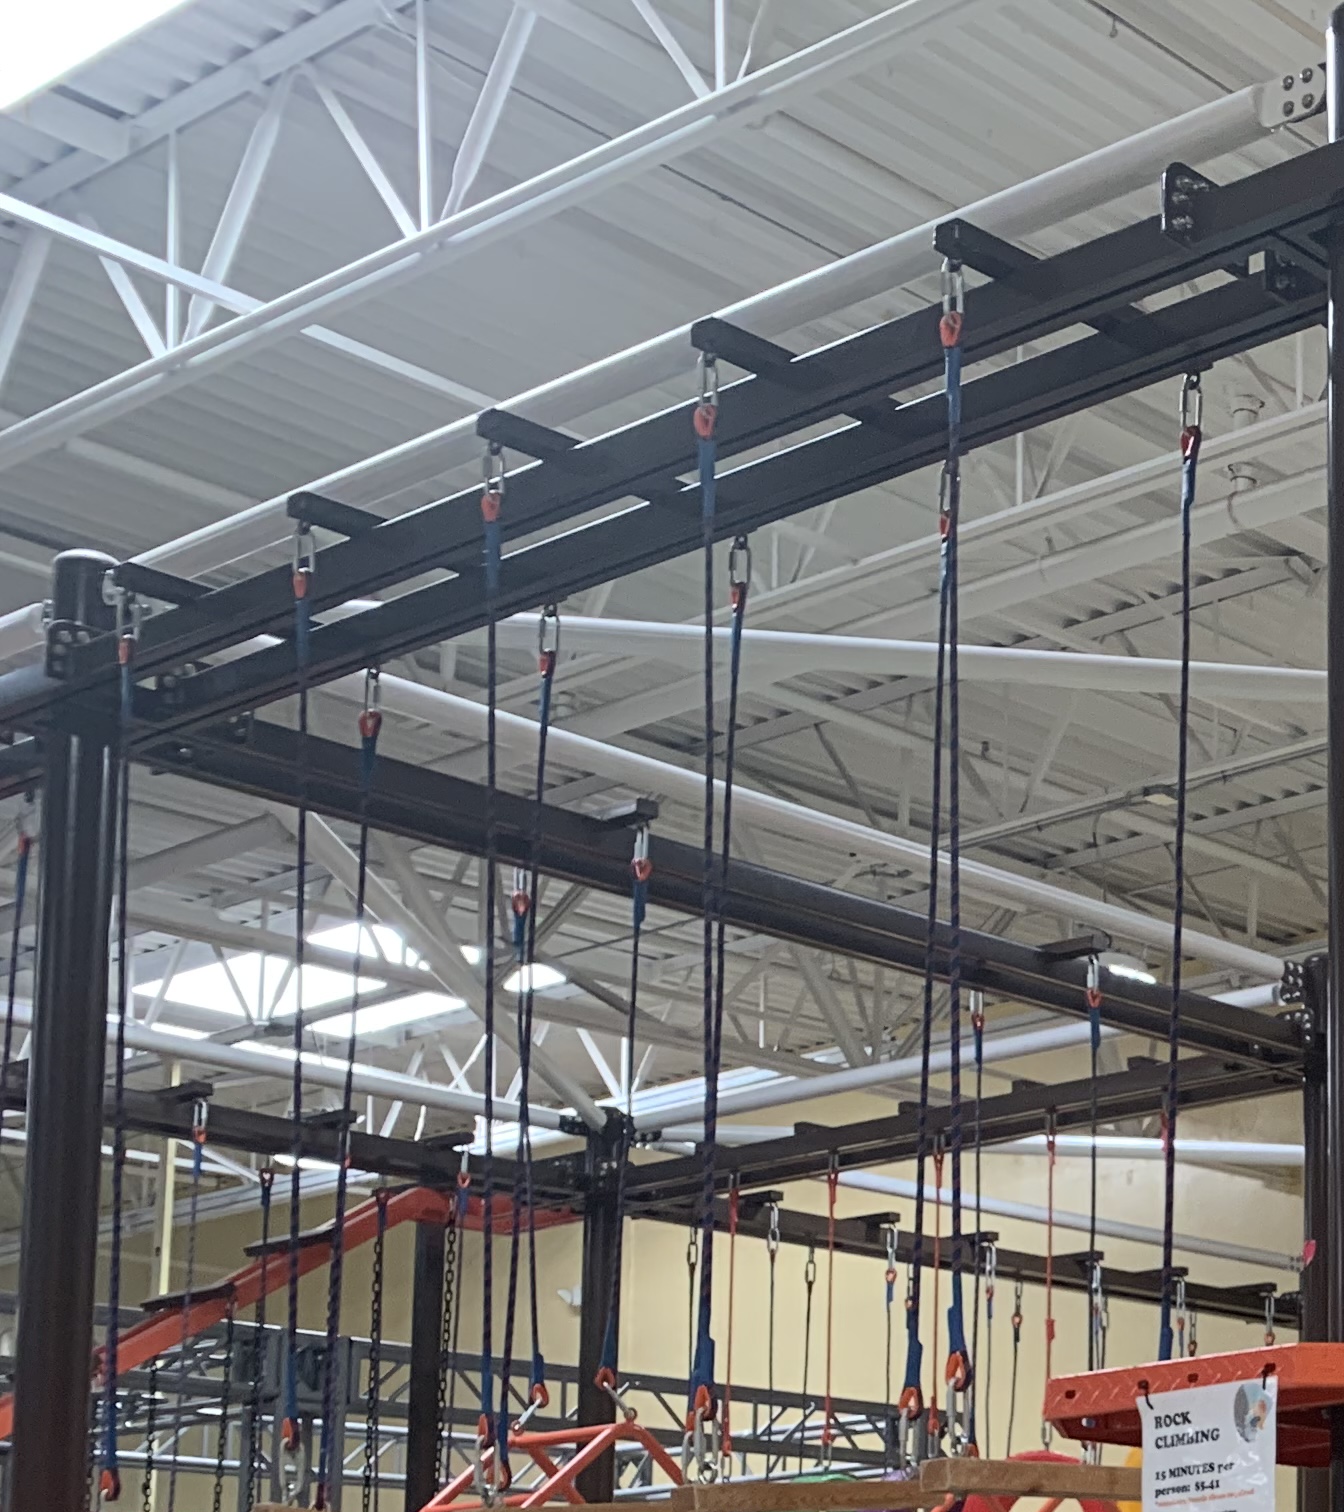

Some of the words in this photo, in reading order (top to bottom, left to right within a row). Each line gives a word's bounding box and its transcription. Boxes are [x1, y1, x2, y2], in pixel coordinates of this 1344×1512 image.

[1154, 1411, 1192, 1429] ROCK
[1155, 1428, 1220, 1449] CLIMBING
[1155, 1471, 1166, 1481] 15
[1169, 1462, 1215, 1479] MINUTES
[1155, 1484, 1190, 1498] person:
[1195, 1480, 1220, 1492] $5.41
